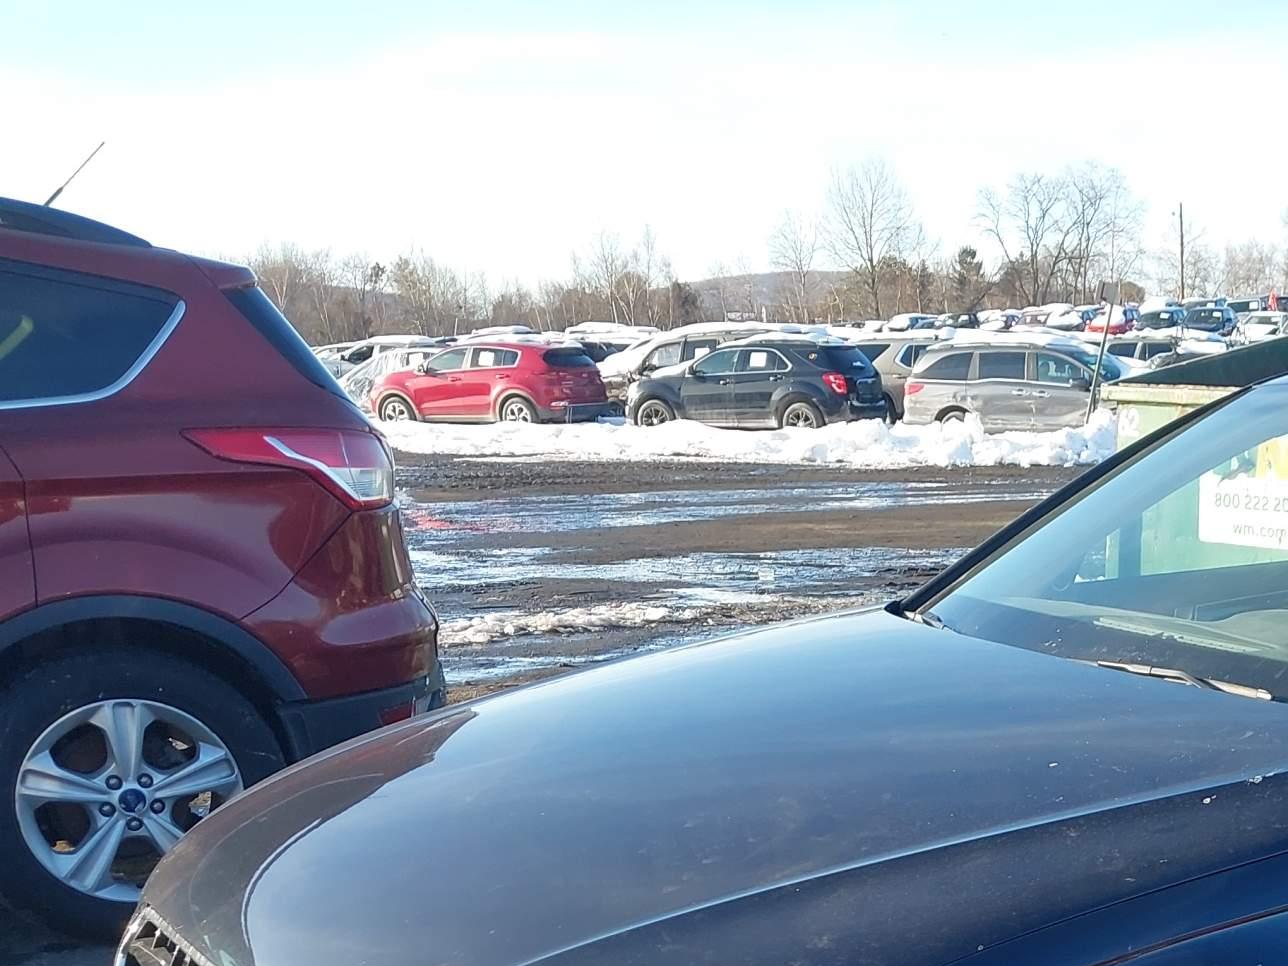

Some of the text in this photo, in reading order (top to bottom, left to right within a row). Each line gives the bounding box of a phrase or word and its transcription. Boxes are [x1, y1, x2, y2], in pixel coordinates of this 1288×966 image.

[1214, 493, 1240, 509] 800
[1244, 494, 1269, 511] 222
[1233, 523, 1287, 538] wm.com
